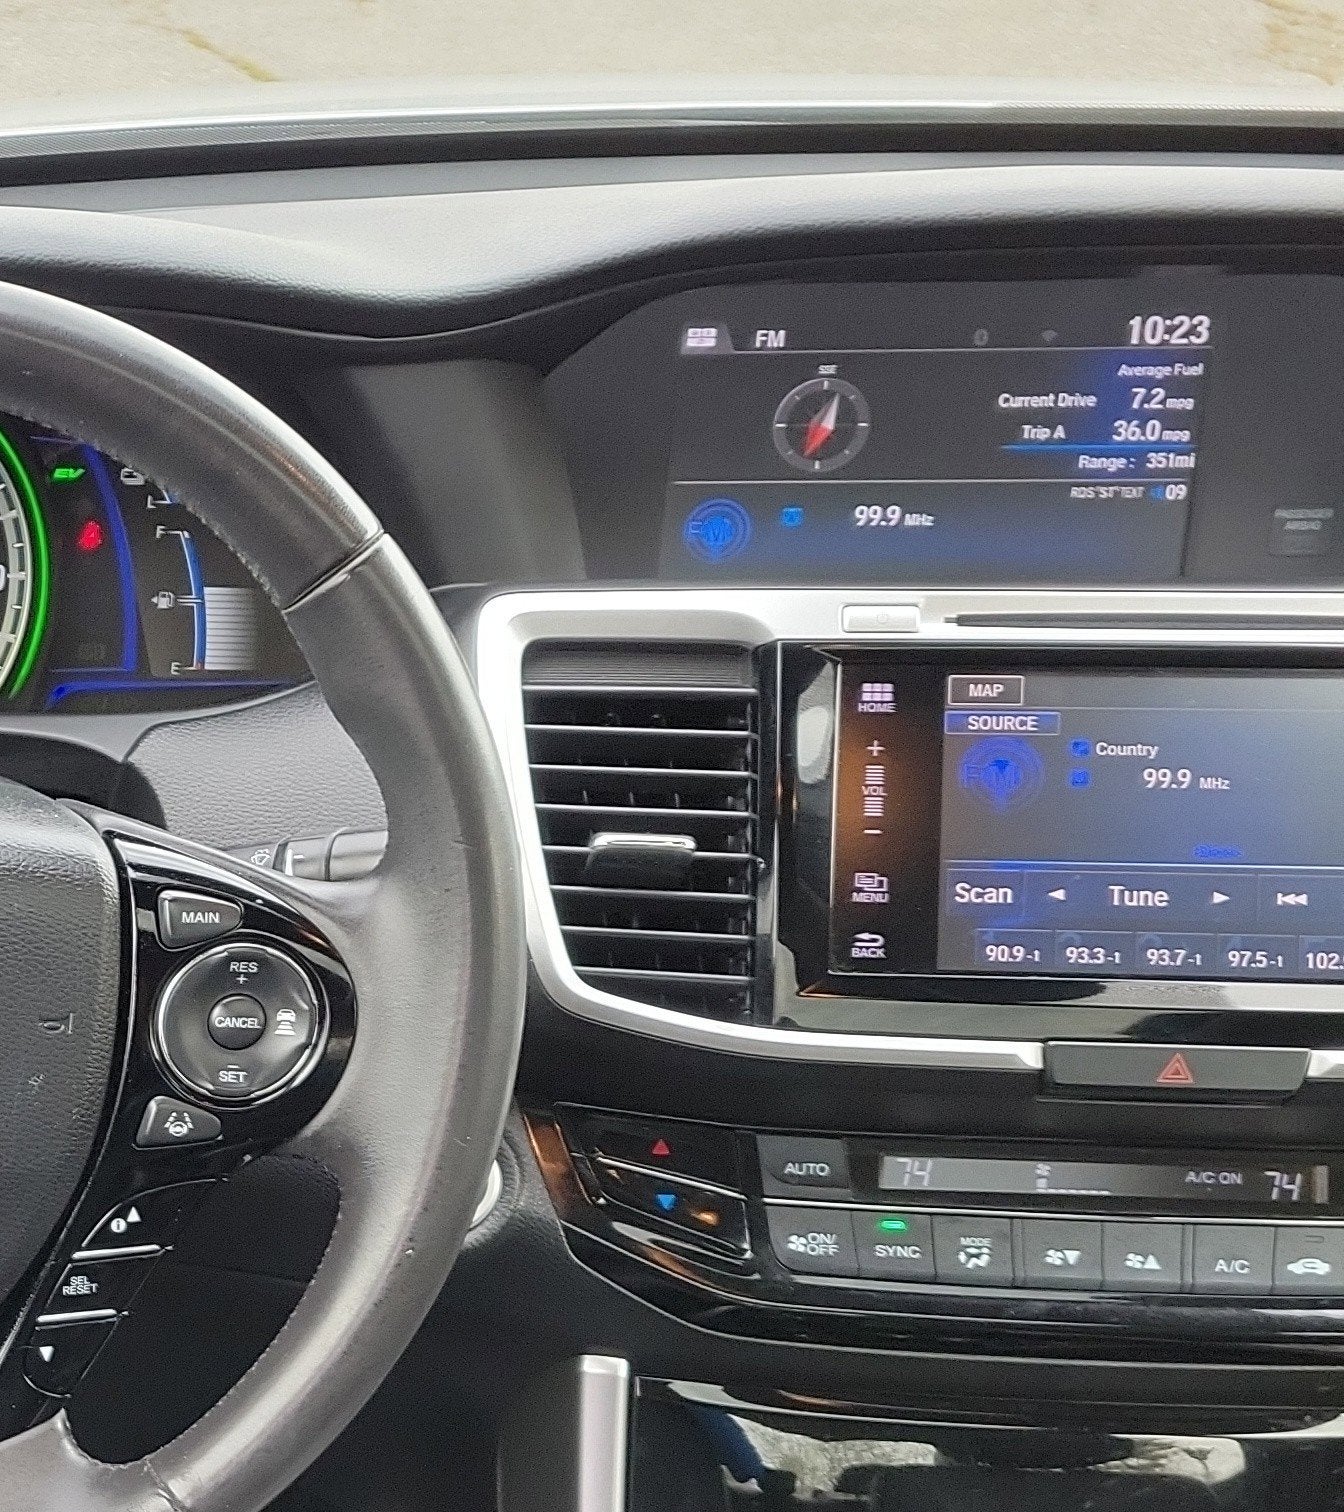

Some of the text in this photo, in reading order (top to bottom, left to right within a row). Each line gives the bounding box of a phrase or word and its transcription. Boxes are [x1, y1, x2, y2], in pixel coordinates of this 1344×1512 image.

[1129, 315, 1211, 345] 10:23
[755, 330, 786, 348] FM
[1117, 362, 1204, 379] Average Fuel
[998, 393, 1055, 408] Current
[1058, 393, 1098, 408] Drive
[1132, 387, 1166, 409] 7.2
[1022, 424, 1052, 441] Trip
[1052, 424, 1066, 440] A
[1112, 420, 1162, 442] 36.0
[1165, 484, 1188, 500] 09
[854, 505, 935, 527] 99.9 MHz
[968, 683, 1004, 697] MAP
[858, 702, 897, 712] HOME
[967, 716, 1039, 731] SOURCE
[1095, 742, 1159, 759] Country
[1142, 768, 1231, 789] 99.9 MHz
[861, 785, 888, 796] VOL
[852, 892, 890, 903] MENU
[954, 882, 1170, 907] Scan Tune
[181, 911, 220, 924] MAIN
[851, 947, 887, 959] BACK
[985, 945, 1042, 962] 90.9-1
[1065, 946, 1121, 964] 93.3-1
[1146, 949, 1202, 966] 93.7-1
[1228, 950, 1284, 968] 97.5-1
[1306, 952, 1344, 969] 102.
[229, 961, 258, 973] RES
[214, 1016, 262, 1029] CANCEL
[218, 1070, 248, 1083] SET
[784, 1162, 830, 1177] AUTO
[895, 1158, 933, 1187] 74
[1185, 1171, 1243, 1185] A/C ON
[1264, 1171, 1302, 1201] 74
[807, 1243, 840, 1256] OFF
[960, 1237, 992, 1247] MODE
[875, 1245, 922, 1259] SYNC
[1215, 1258, 1250, 1274] A/C
[70, 1275, 91, 1286] SEL
[62, 1283, 99, 1296] RESET
